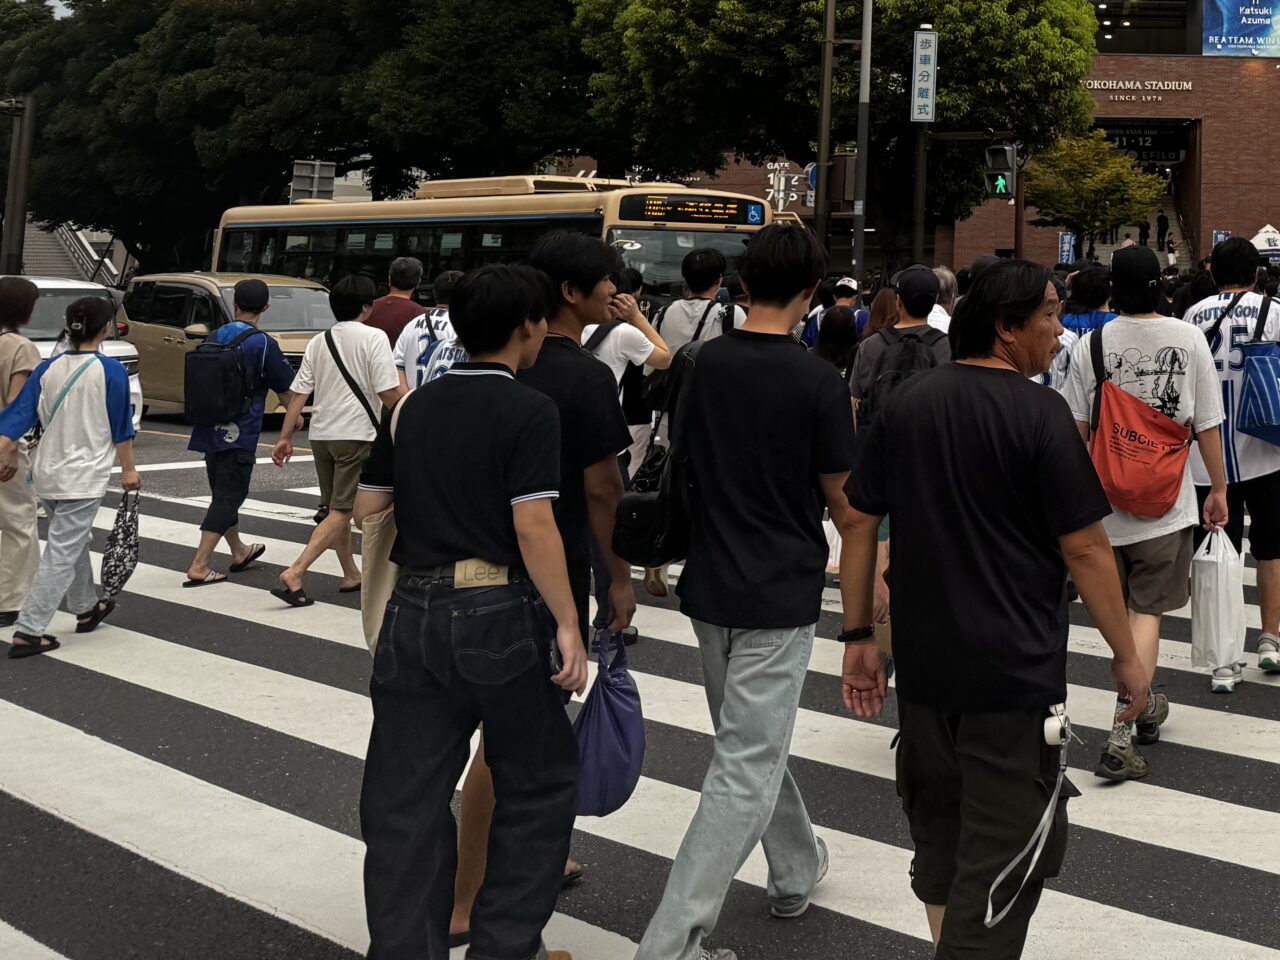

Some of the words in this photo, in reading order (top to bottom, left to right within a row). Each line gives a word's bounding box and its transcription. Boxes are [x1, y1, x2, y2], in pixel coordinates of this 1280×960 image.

[1239, 6, 1273, 15] Katsuki
[1240, 16, 1271, 25] Azuma
[916, 38, 933, 117] 歩車分離式
[1144, 81, 1193, 91] STADIUM
[767, 162, 790, 170] GATE
